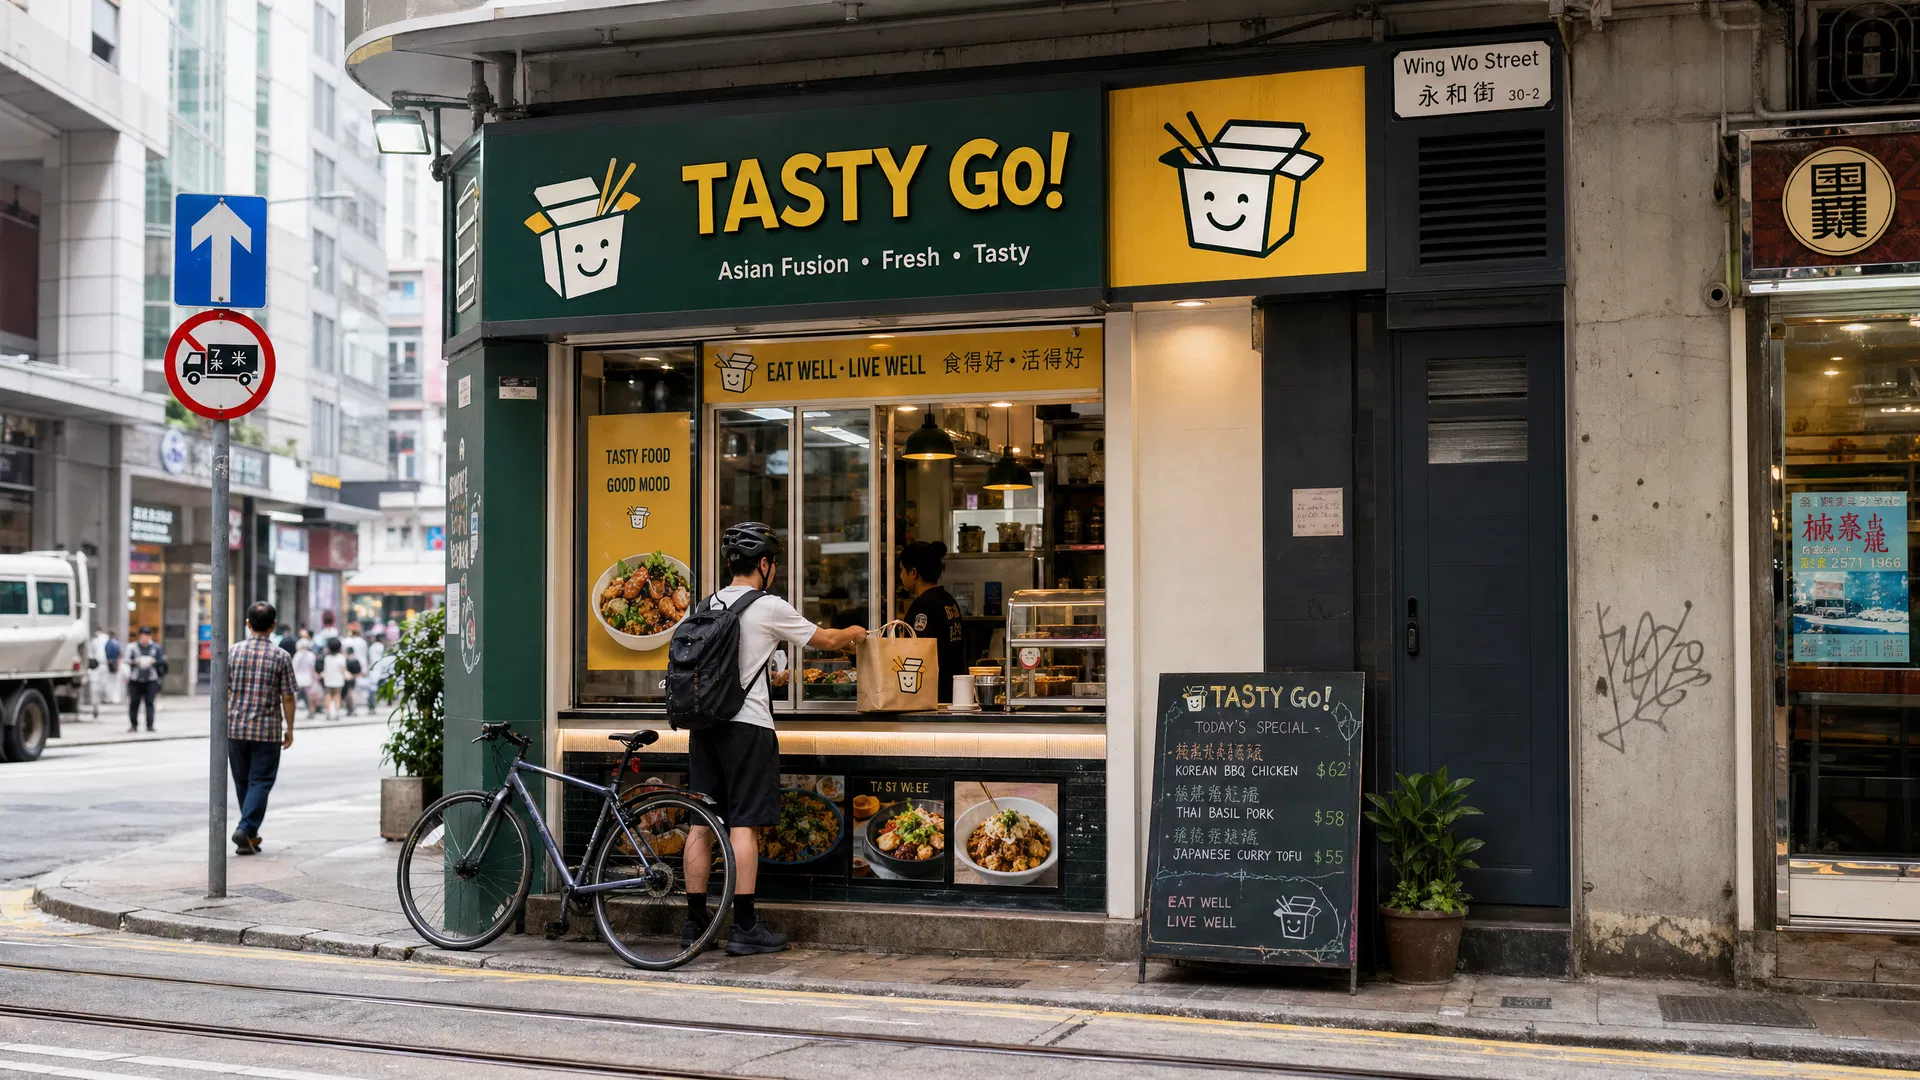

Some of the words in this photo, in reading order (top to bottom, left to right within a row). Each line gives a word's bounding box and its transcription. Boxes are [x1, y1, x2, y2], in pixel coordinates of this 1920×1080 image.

[1403, 57, 1445, 77] Wing
[1450, 54, 1479, 72] Wo
[1484, 50, 1539, 70] Street
[1418, 81, 1495, 107] 永和街
[1508, 88, 1540, 101] 30-2
[682, 144, 929, 235] TASTY
[718, 259, 774, 281] Asian
[781, 254, 849, 277] Fusion
[882, 246, 940, 270] Fresh
[973, 243, 1031, 267] Tasty
[767, 360, 793, 382] EAT
[797, 358, 837, 380] WELL
[848, 356, 880, 378] LIVE
[885, 354, 926, 376] WELL
[605, 448, 639, 465] TASTY
[641, 447, 671, 464] FOOD
[607, 477, 636, 493] GOOD
[639, 476, 670, 492] MOOD
[1831, 557, 1862, 569] 2571
[1870, 557, 1901, 569] 1966
[1210, 684, 1284, 708] TASTY
[1194, 719, 1246, 734] TODAY'S
[1256, 720, 1309, 734] SPECIAL
[1175, 764, 1217, 776] KOREAN
[1224, 765, 1246, 778] BBQ
[1251, 765, 1298, 776] CHICKEN
[1316, 761, 1348, 779] $62
[1176, 806, 1201, 818] THAI
[1209, 806, 1240, 819] BASIL
[1246, 807, 1274, 820] PORK
[1314, 808, 1345, 827] $58
[1172, 847, 1231, 860] JAPANESE
[1237, 849, 1272, 861] CURRY
[1275, 850, 1302, 861] TOFU
[1313, 849, 1344, 865] $55
[1168, 895, 1195, 908] EAT
[1200, 896, 1232, 909] WELL
[1167, 915, 1197, 928] LIVE
[1203, 916, 1237, 928] WELL
